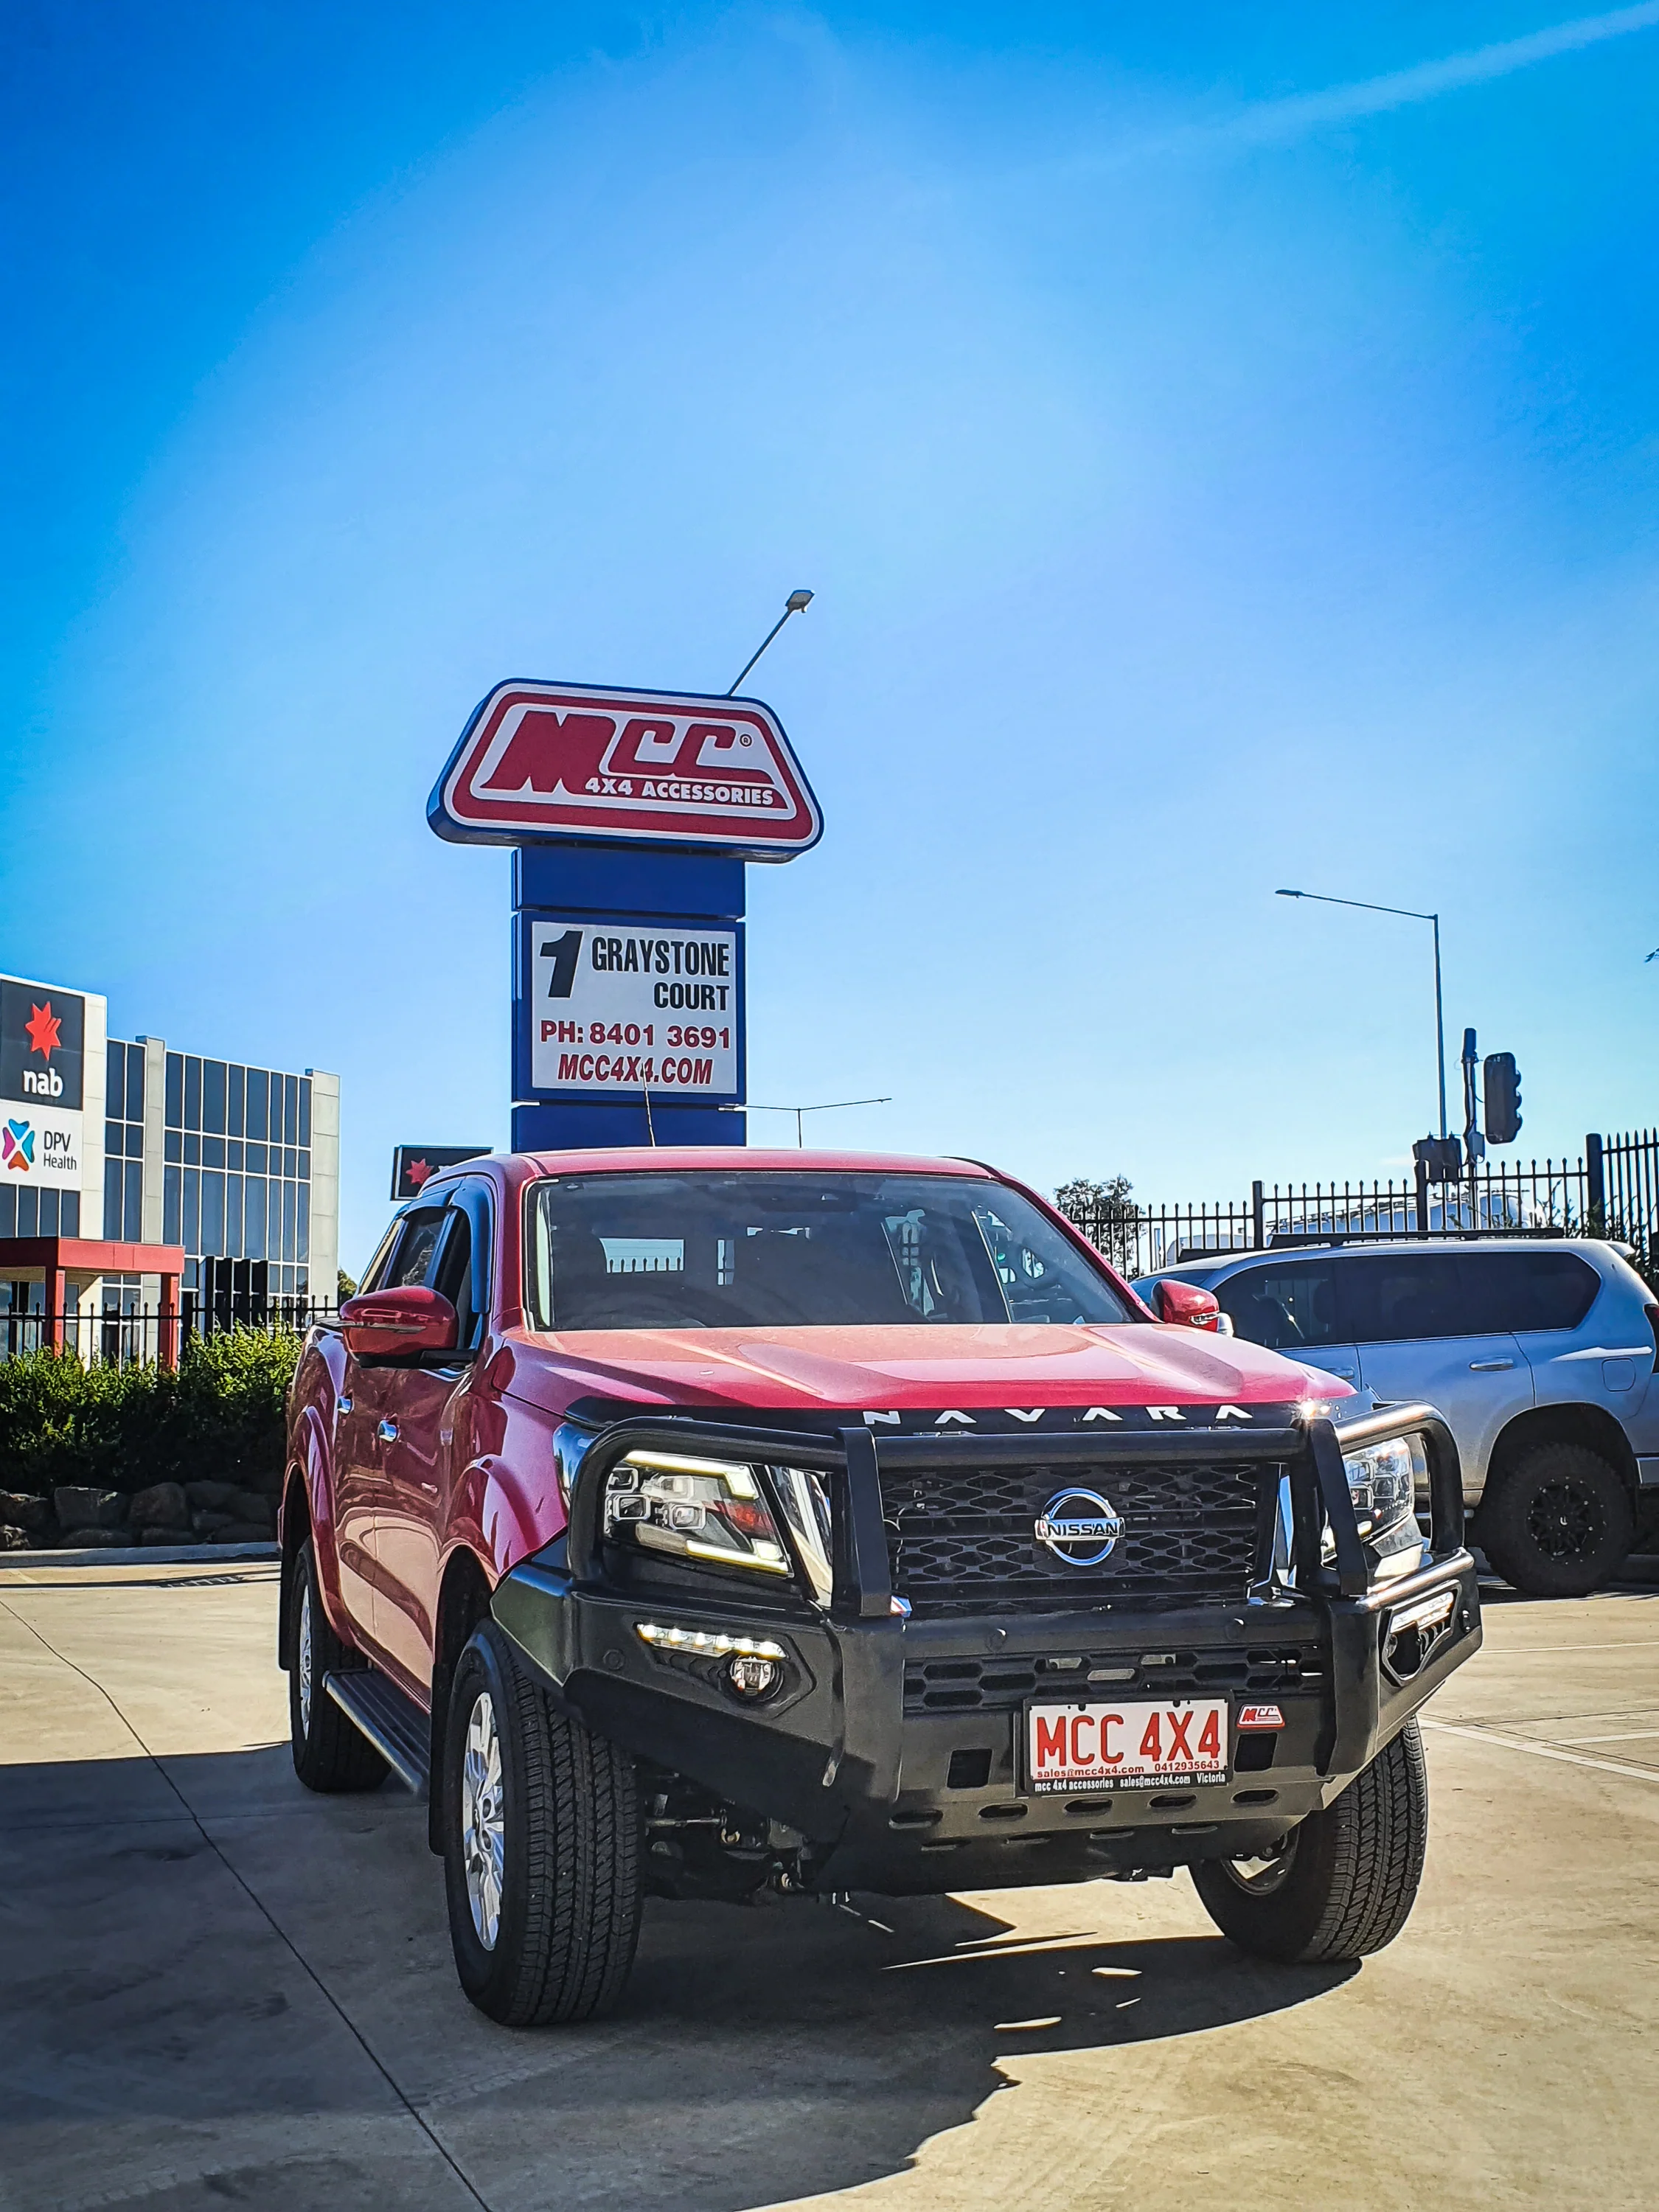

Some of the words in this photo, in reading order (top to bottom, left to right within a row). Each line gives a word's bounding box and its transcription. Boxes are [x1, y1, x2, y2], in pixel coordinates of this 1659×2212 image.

[480, 709, 776, 795] MCC
[585, 777, 633, 795] 4X4
[641, 781, 773, 805] ACCESSORIES
[540, 931, 583, 998] 1
[592, 936, 729, 977] GRAYSTONE
[654, 982, 729, 1011] COURT
[540, 1020, 583, 1043] PH:
[590, 1022, 654, 1046] 8401
[667, 1025, 729, 1048] 3691
[23, 1068, 63, 1097] nab
[557, 1054, 713, 1085] MCC4X4.COM
[44, 1130, 71, 1152] DPV
[44, 1153, 77, 1171] Health
[863, 1405, 1253, 1425] NAVARA
[1047, 1522, 1119, 1536] NISSAN
[1037, 1714, 1124, 1767] MCC
[1139, 1710, 1220, 1762] 4X4
[1034, 1781, 1051, 1792] mcc
[1053, 1778, 1067, 1790] 4x4
[1068, 1777, 1113, 1790] accessories
[1120, 1774, 1191, 1788] sales@mcc4x4.com
[1197, 1771, 1225, 1784] Victoria
[1037, 1765, 1144, 1778] sales@mcc4x4.com
[1155, 1760, 1220, 1772] 0412935643
